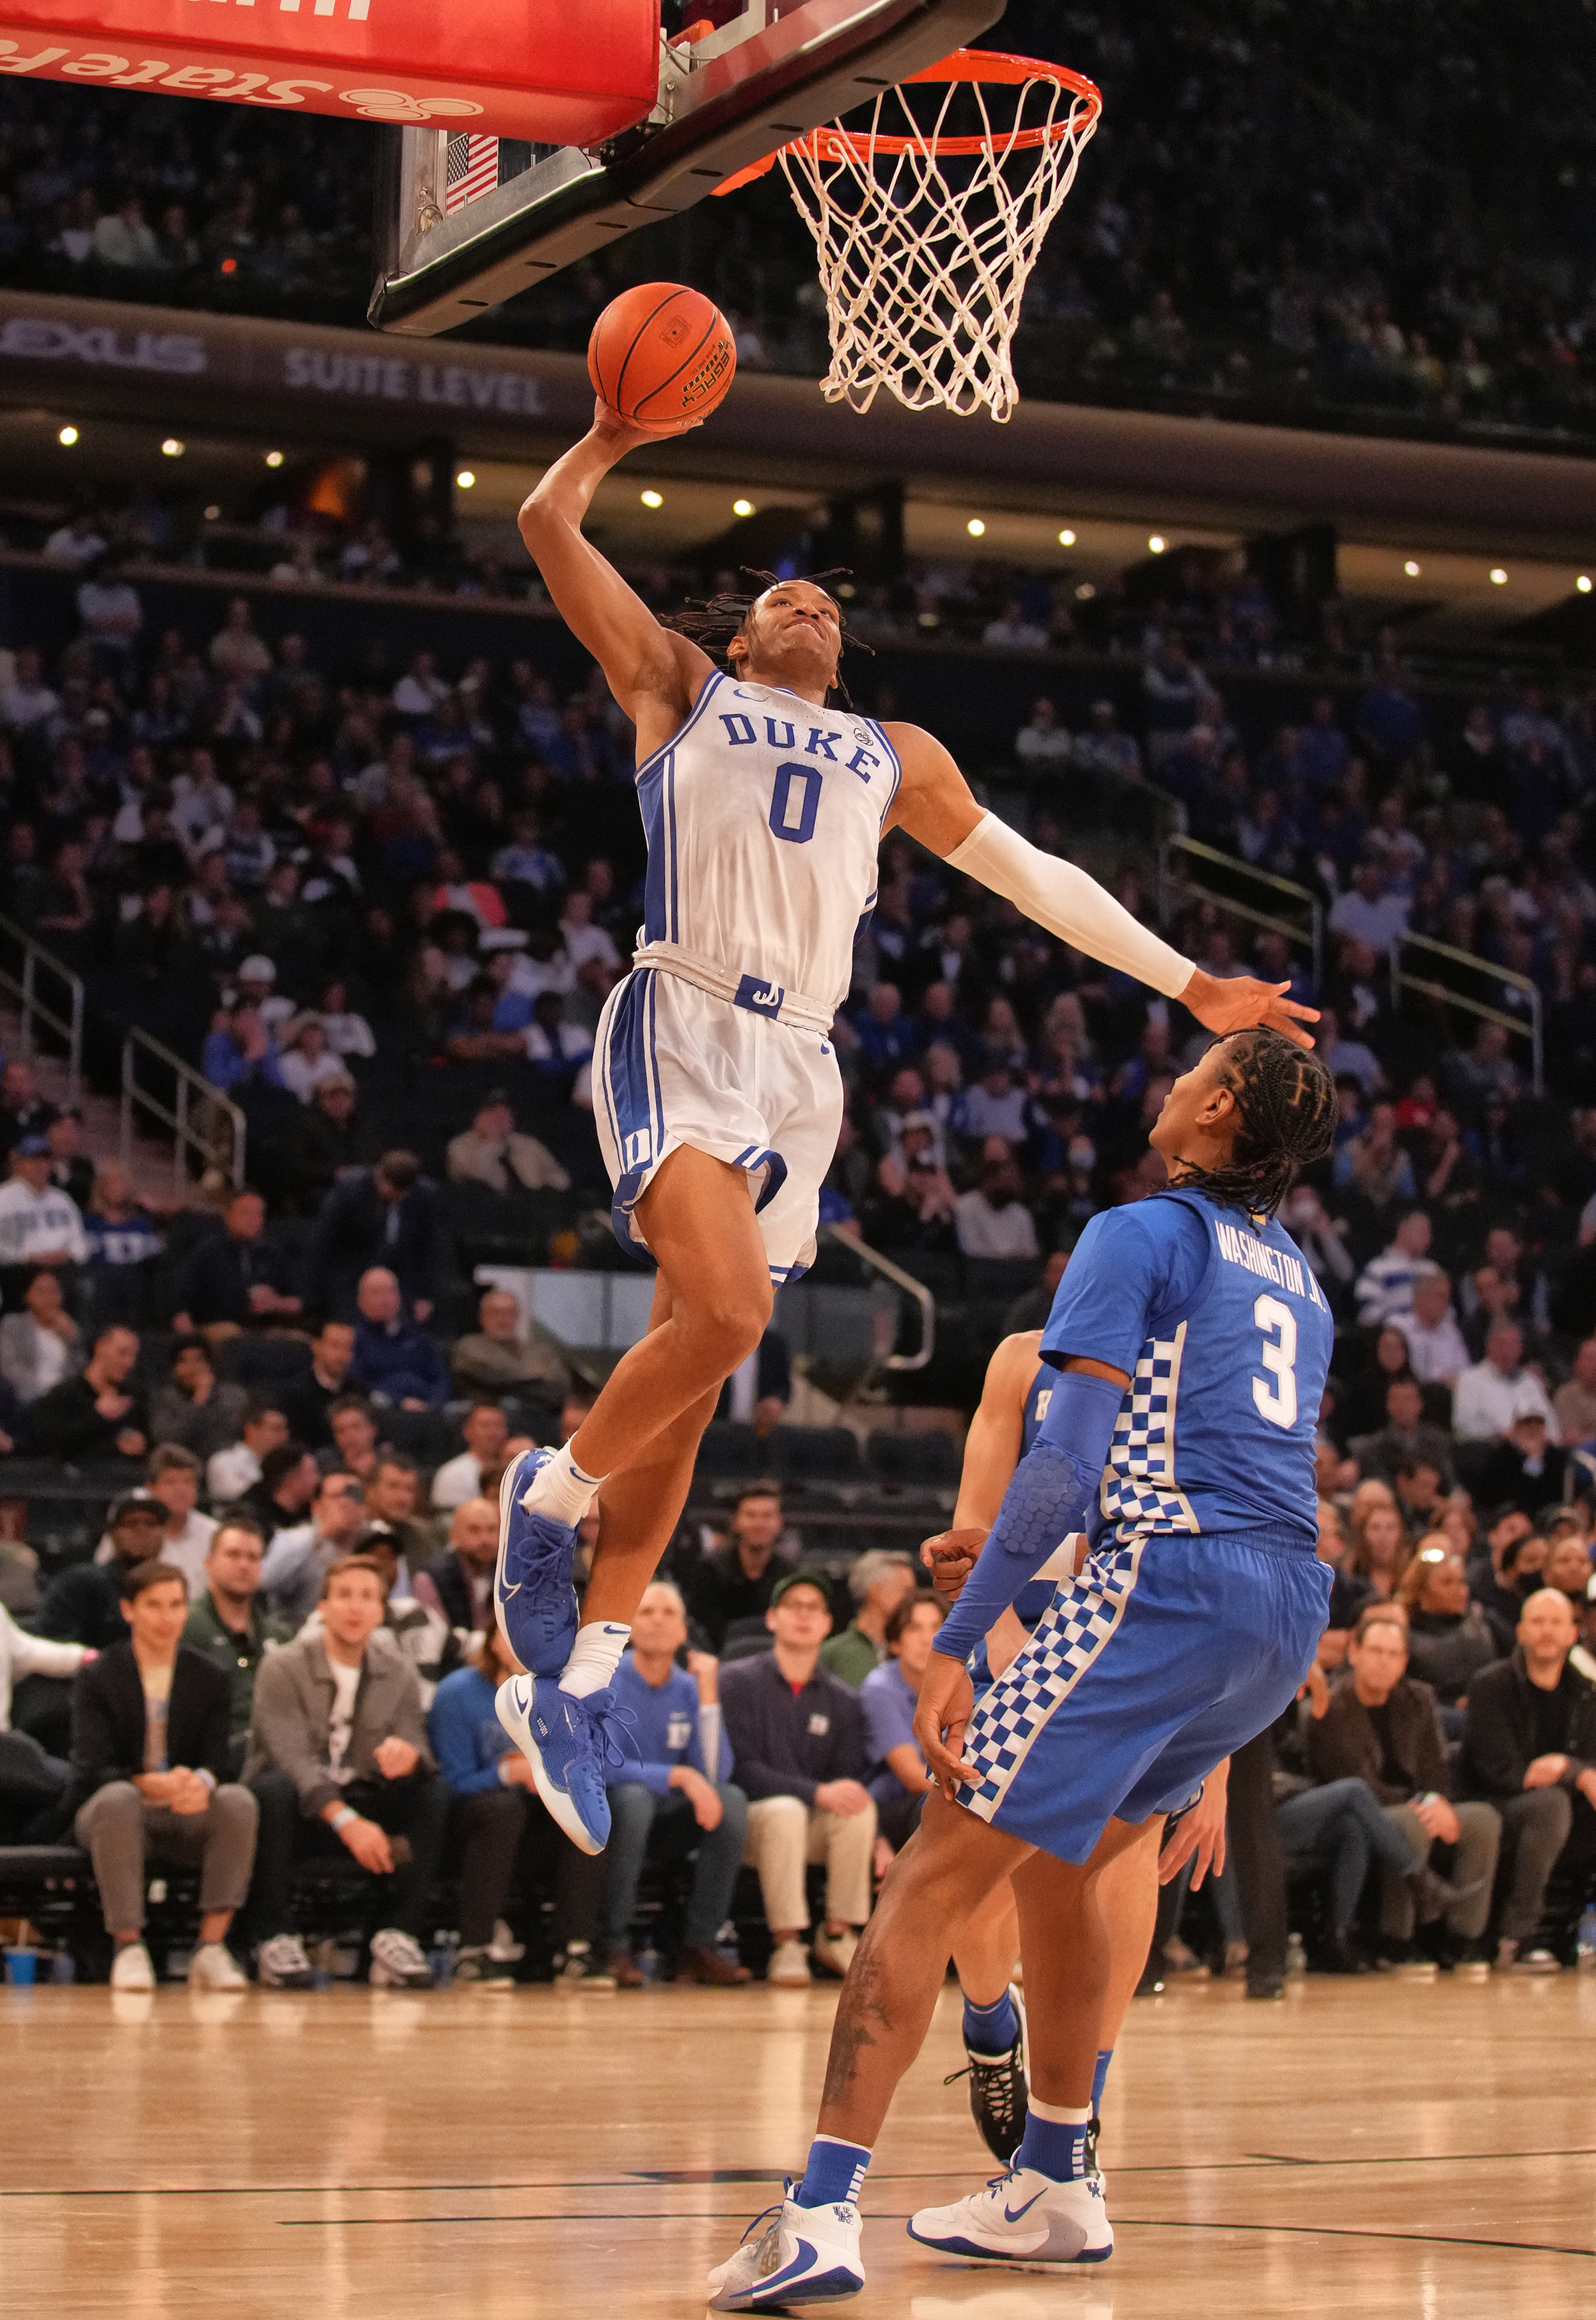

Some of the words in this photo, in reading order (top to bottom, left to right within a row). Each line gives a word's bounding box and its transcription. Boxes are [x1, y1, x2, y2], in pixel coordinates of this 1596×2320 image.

[284, 347, 406, 398] SUITE
[418, 364, 545, 416] LEVEL
[682, 339, 733, 408] LEGACY
[719, 714, 880, 784] DUKE
[769, 762, 823, 844] 0
[1214, 1219, 1305, 1297] WASHINGTON
[1252, 1293, 1297, 1429] 3
